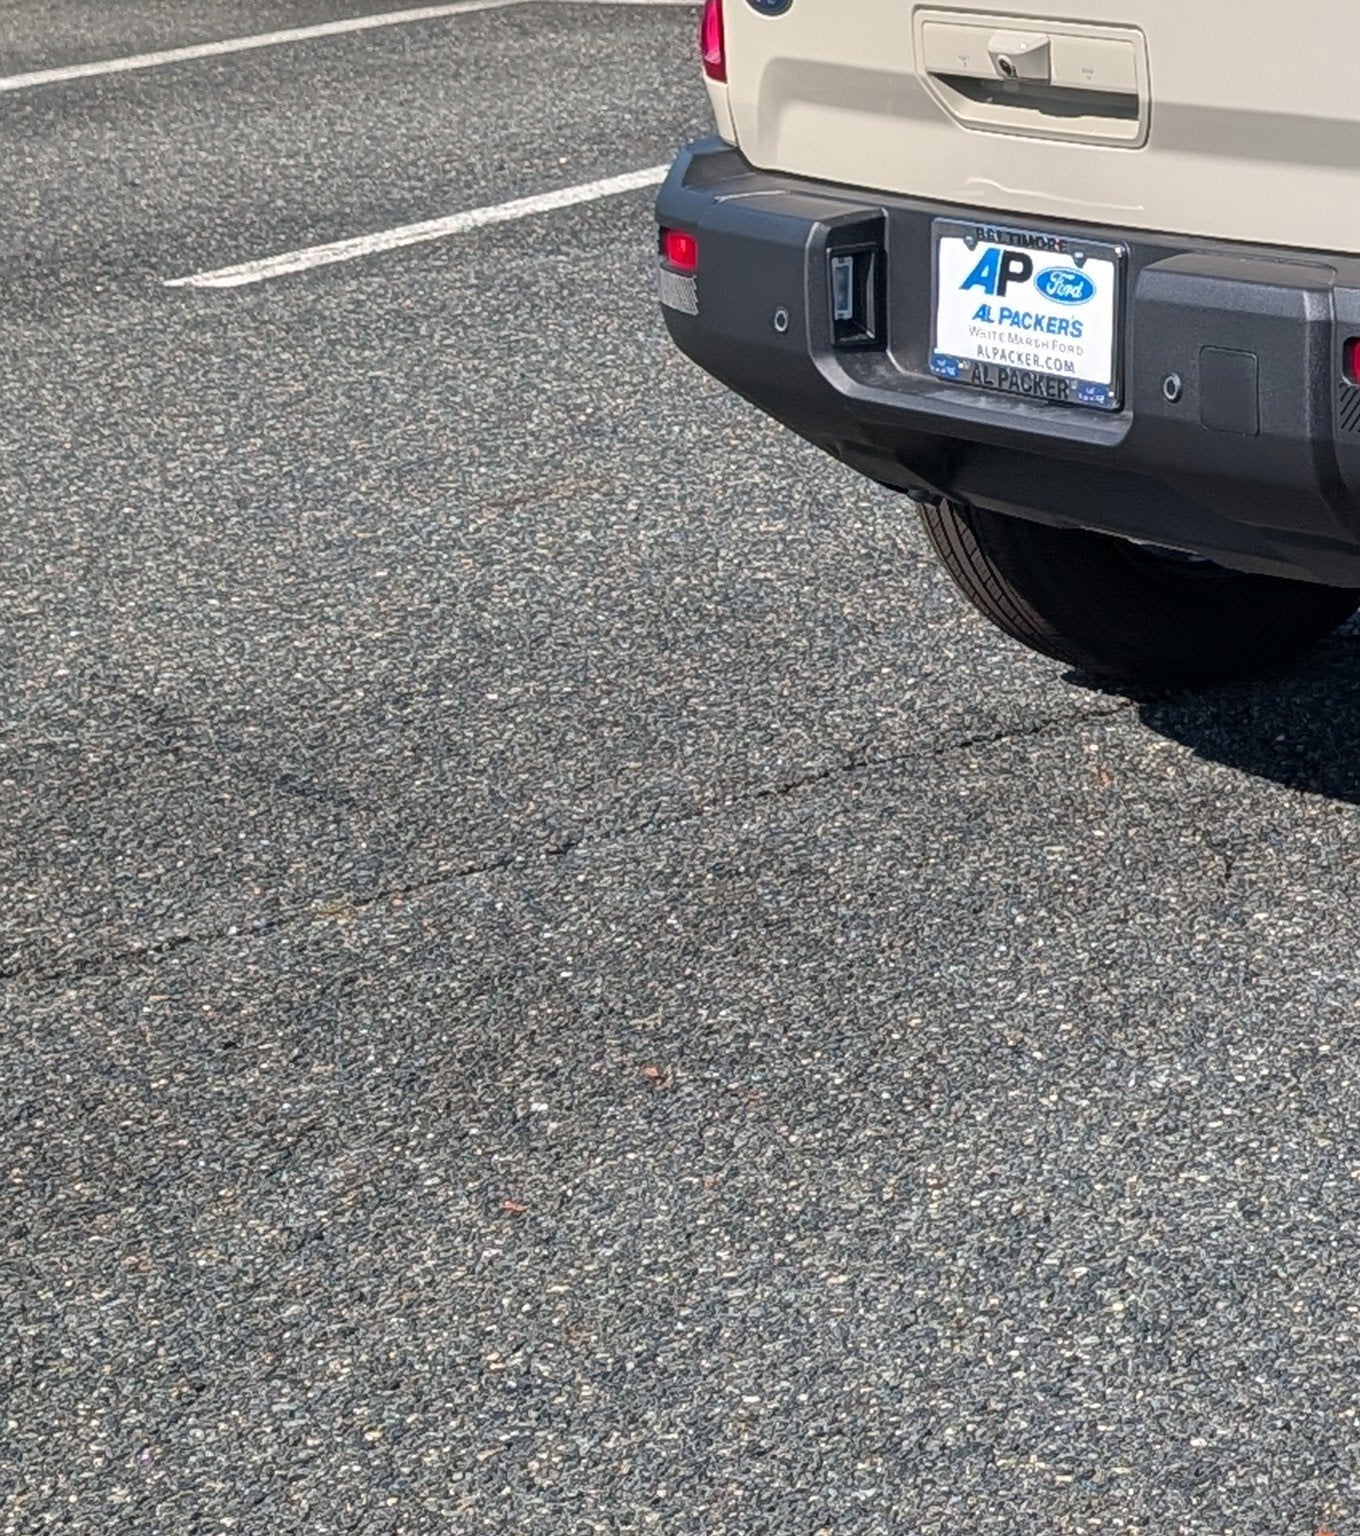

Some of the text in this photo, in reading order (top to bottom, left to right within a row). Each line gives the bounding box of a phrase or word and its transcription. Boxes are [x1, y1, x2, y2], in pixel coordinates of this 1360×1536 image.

[975, 226, 1068, 252] BALTIMORE
[958, 247, 1086, 300] AP Ford
[971, 303, 995, 324] AL
[977, 344, 1076, 373] ALPACKER.COM
[1052, 339, 1084, 356] FORD
[971, 363, 994, 385] AL
[998, 367, 1069, 400] PACKER
